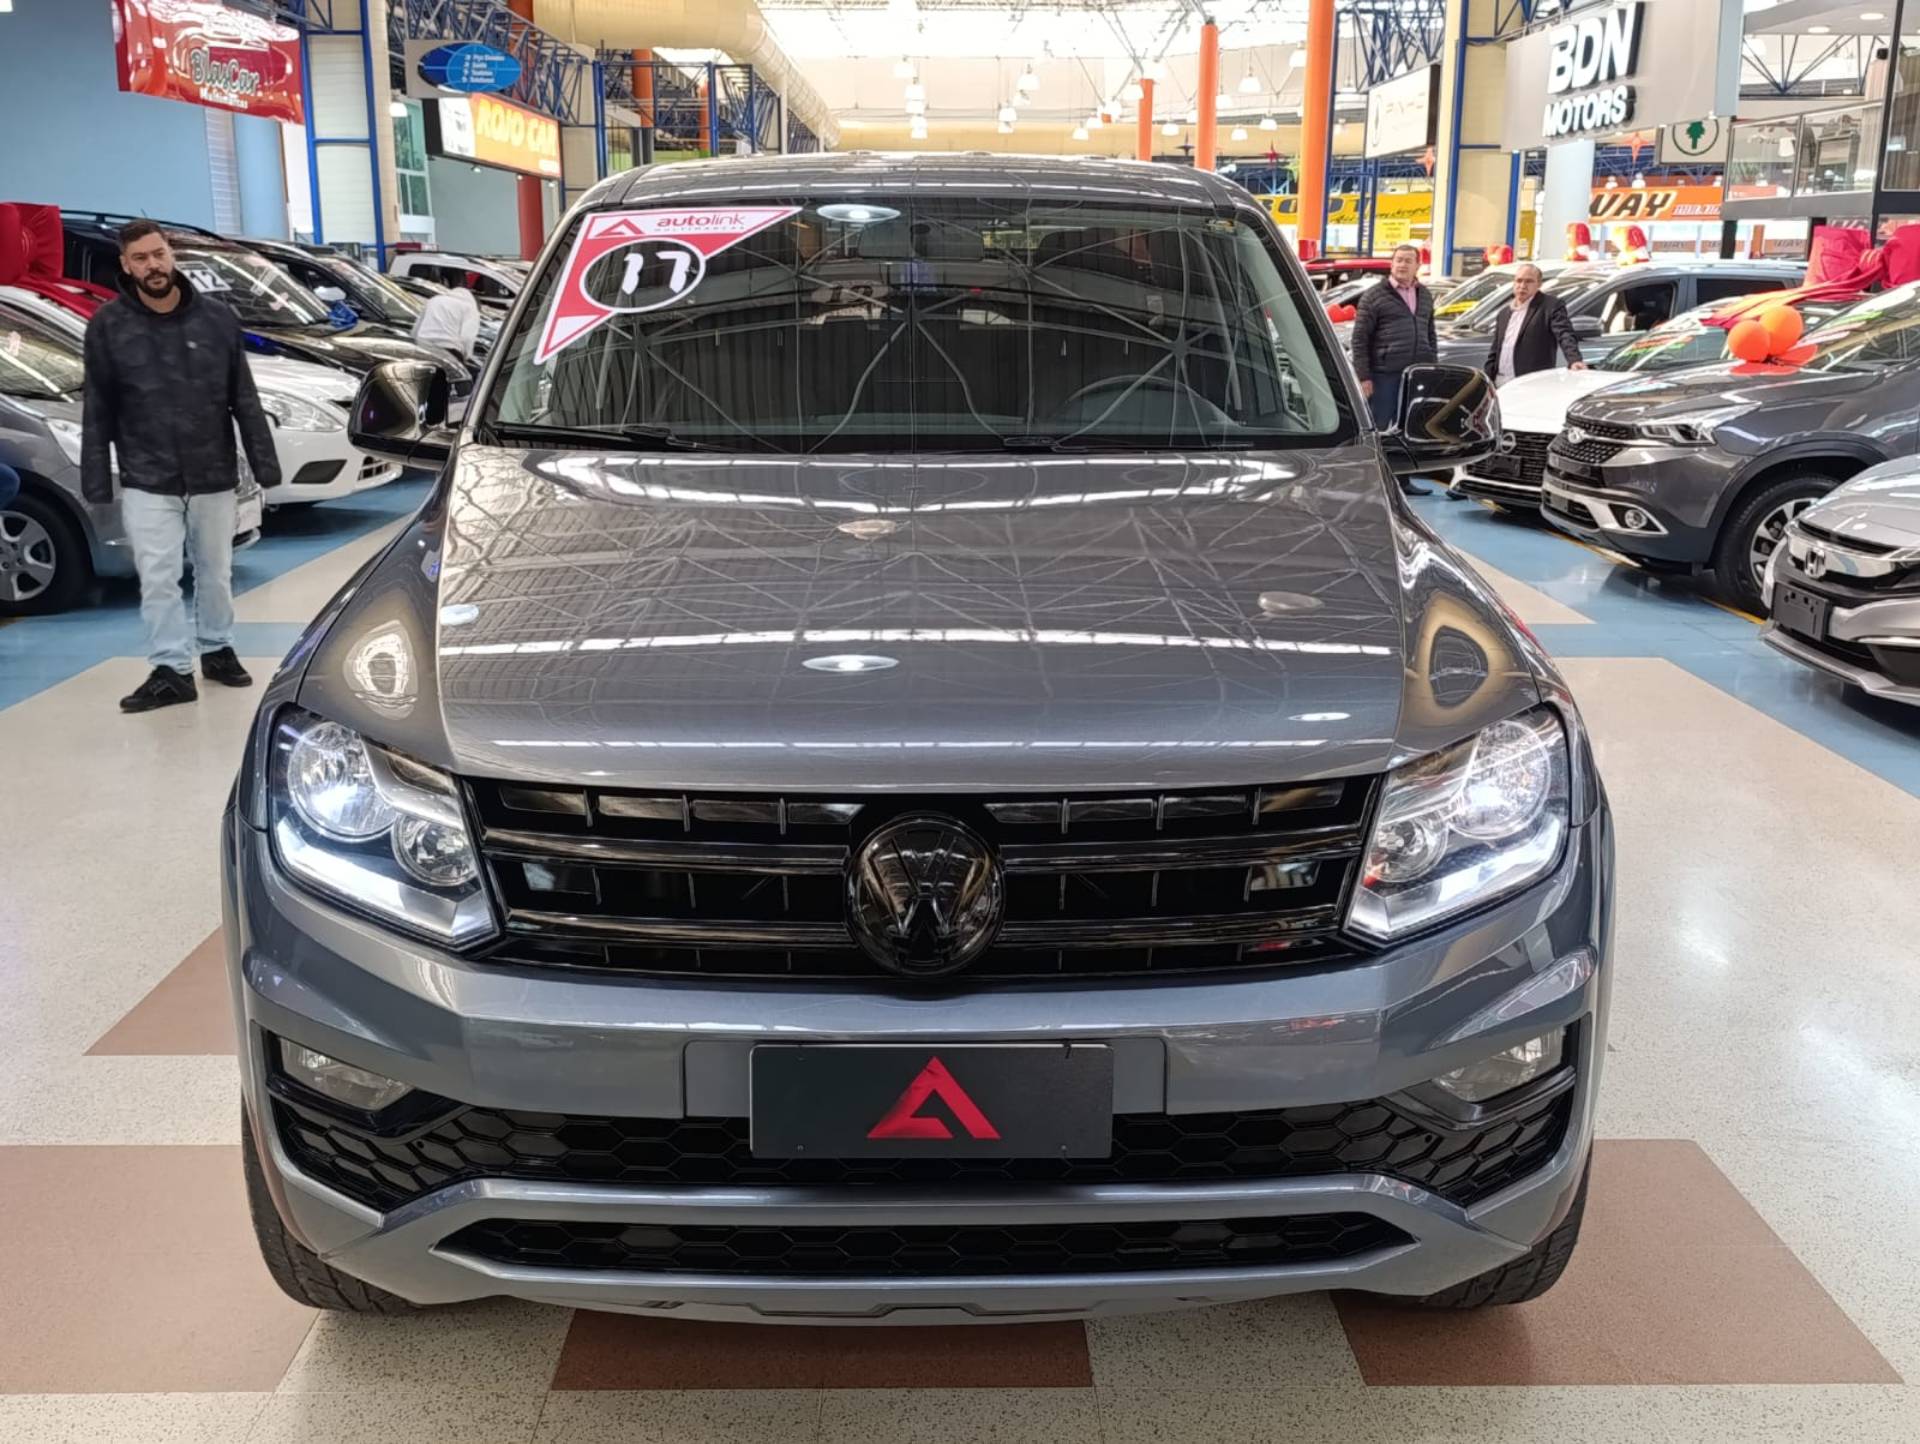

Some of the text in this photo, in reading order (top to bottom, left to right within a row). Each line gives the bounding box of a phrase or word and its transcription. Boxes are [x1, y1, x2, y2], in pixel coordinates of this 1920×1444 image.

[1547, 1, 1640, 95] BDN
[1542, 85, 1633, 137] MOTORS
[656, 211, 746, 228] autolink
[189, 269, 226, 290] 12
[621, 251, 692, 296] 17
